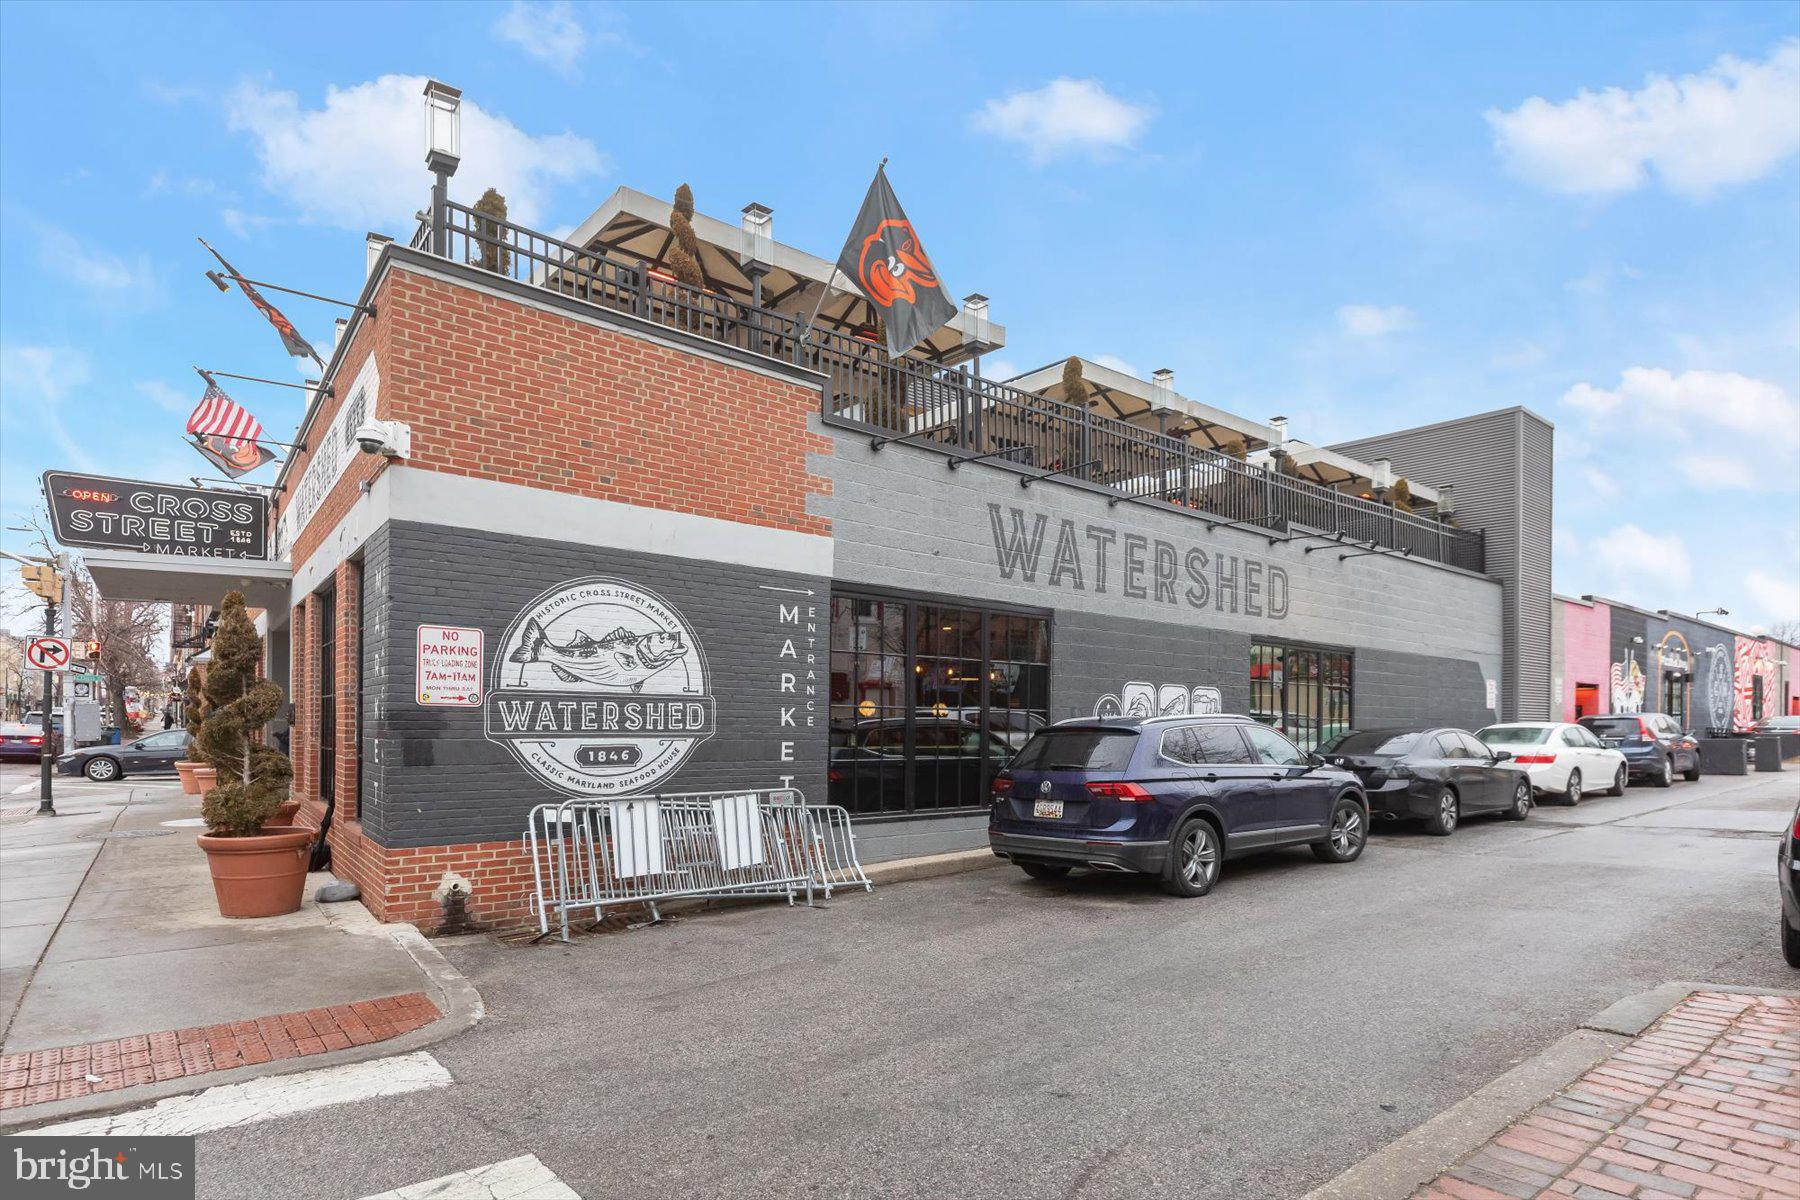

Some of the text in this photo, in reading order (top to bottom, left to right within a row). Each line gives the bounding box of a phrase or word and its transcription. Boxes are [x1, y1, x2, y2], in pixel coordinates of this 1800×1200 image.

[72, 489, 110, 503] OPEN
[130, 491, 254, 524] CROSS
[70, 509, 219, 544] STREET
[230, 529, 252, 537] ESTD
[156, 543, 235, 559] MARKET
[987, 502, 1289, 620] WATERSHED
[536, 589, 679, 630] HISTORIC CROSS STREET MARKET
[422, 644, 478, 656] PARKING
[442, 630, 459, 641] NO
[806, 606, 816, 727] ENTRANCE
[779, 604, 799, 789] MARKET
[498, 700, 705, 731] WATERSHED
[531, 747, 681, 789] CLASSIC MARYLAND SEAFOOD HOUSE
[588, 750, 630, 762] 1846
